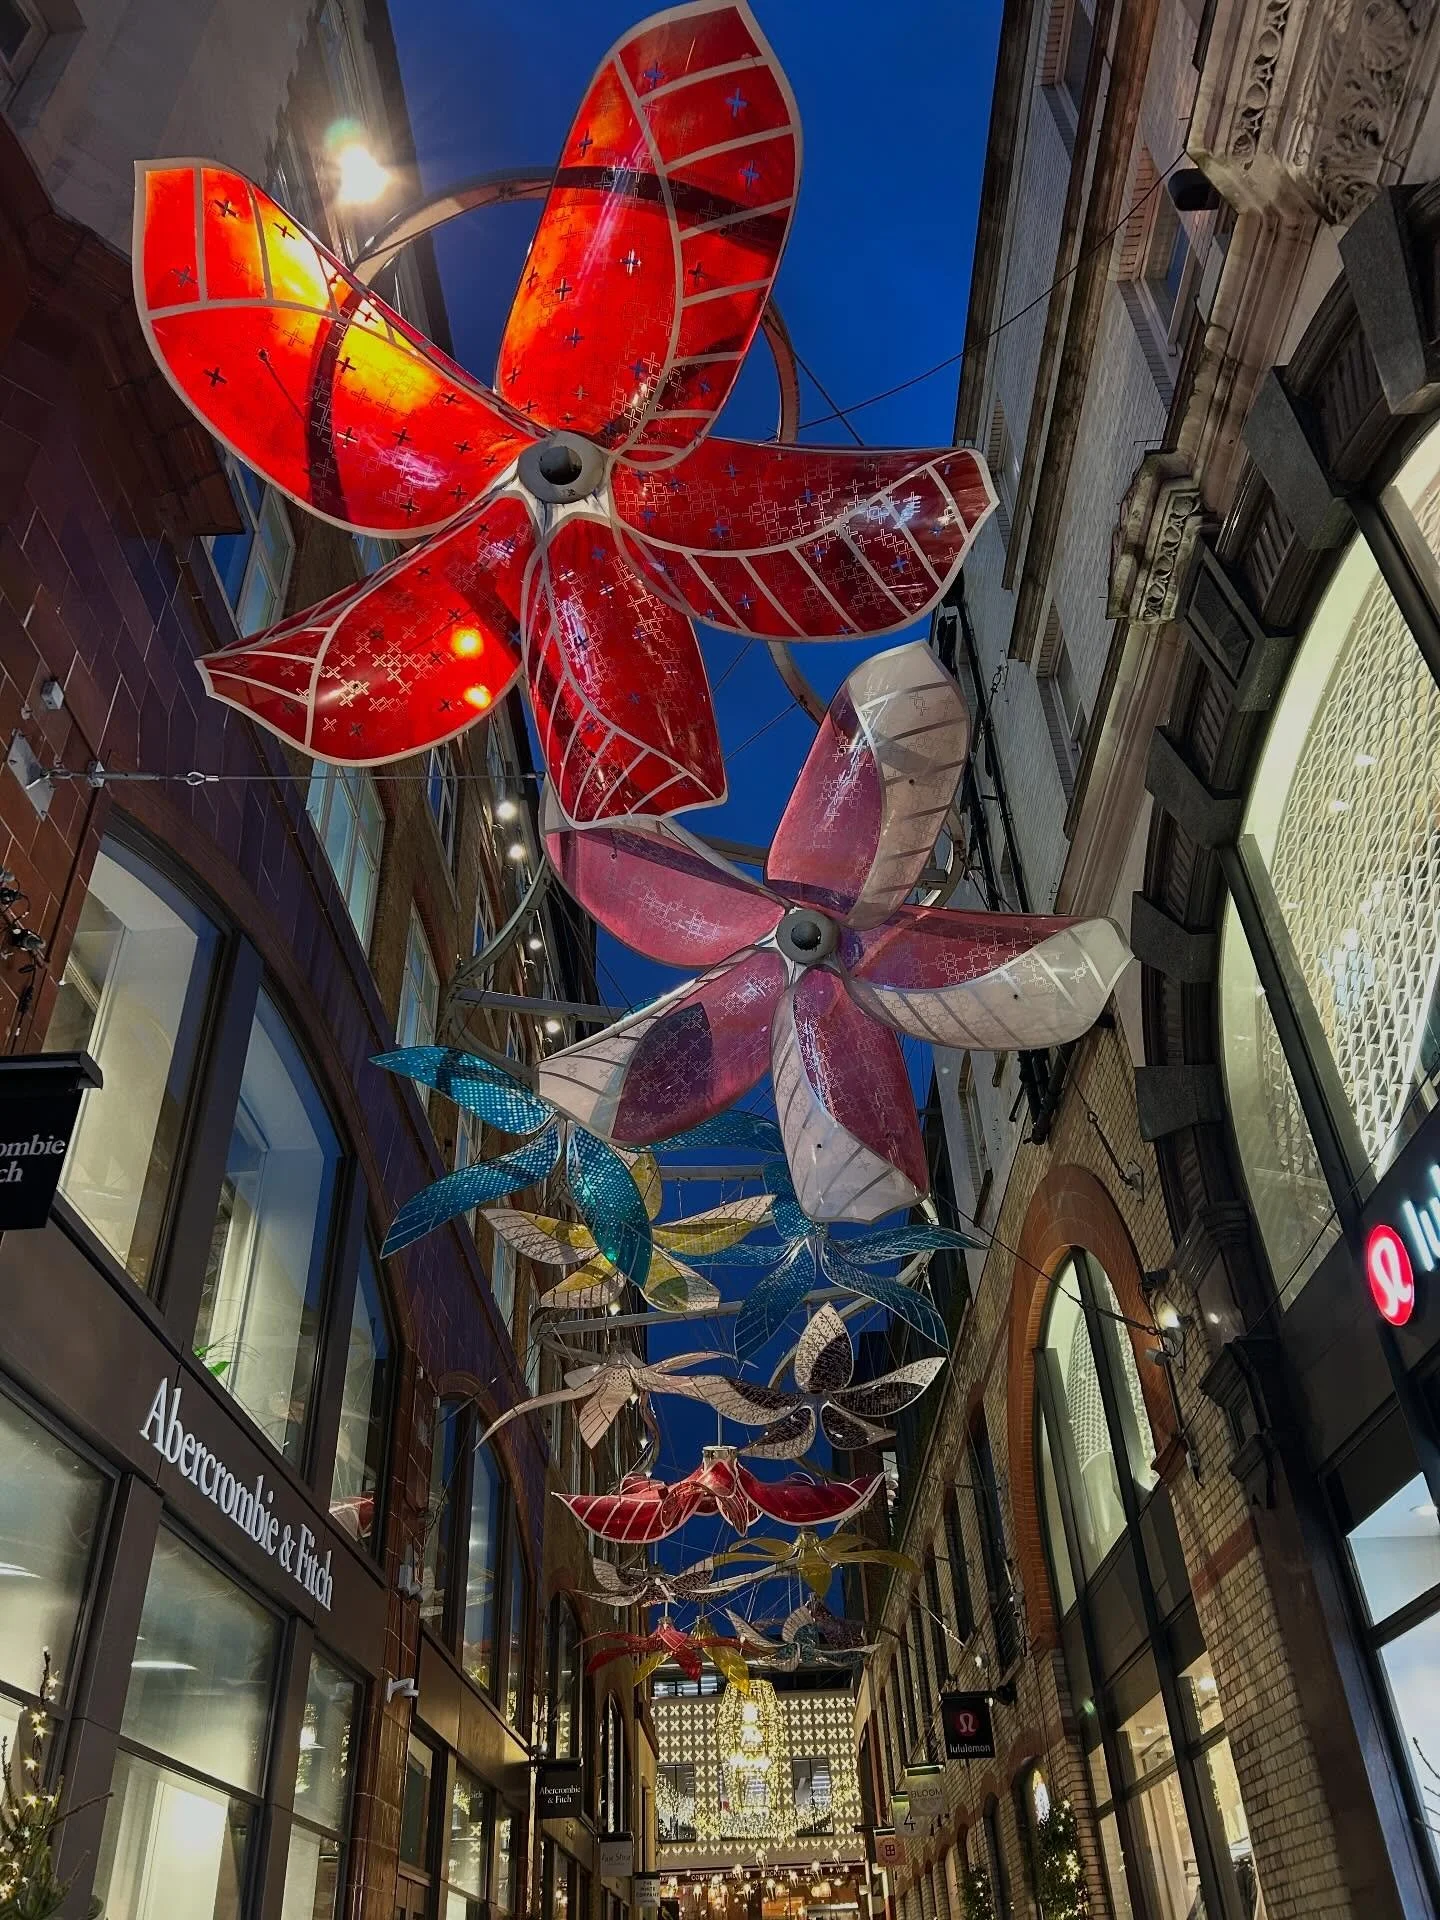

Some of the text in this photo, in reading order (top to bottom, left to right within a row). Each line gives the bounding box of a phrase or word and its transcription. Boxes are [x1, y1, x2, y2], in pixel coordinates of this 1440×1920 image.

[138, 1377, 334, 1612] Abercrombie & Fitch
[949, 1743, 991, 1753] lululemon
[539, 1784, 581, 1795] Abercrombie
[911, 1788, 943, 1798] BLOOM
[555, 1794, 572, 1804] Fitch
